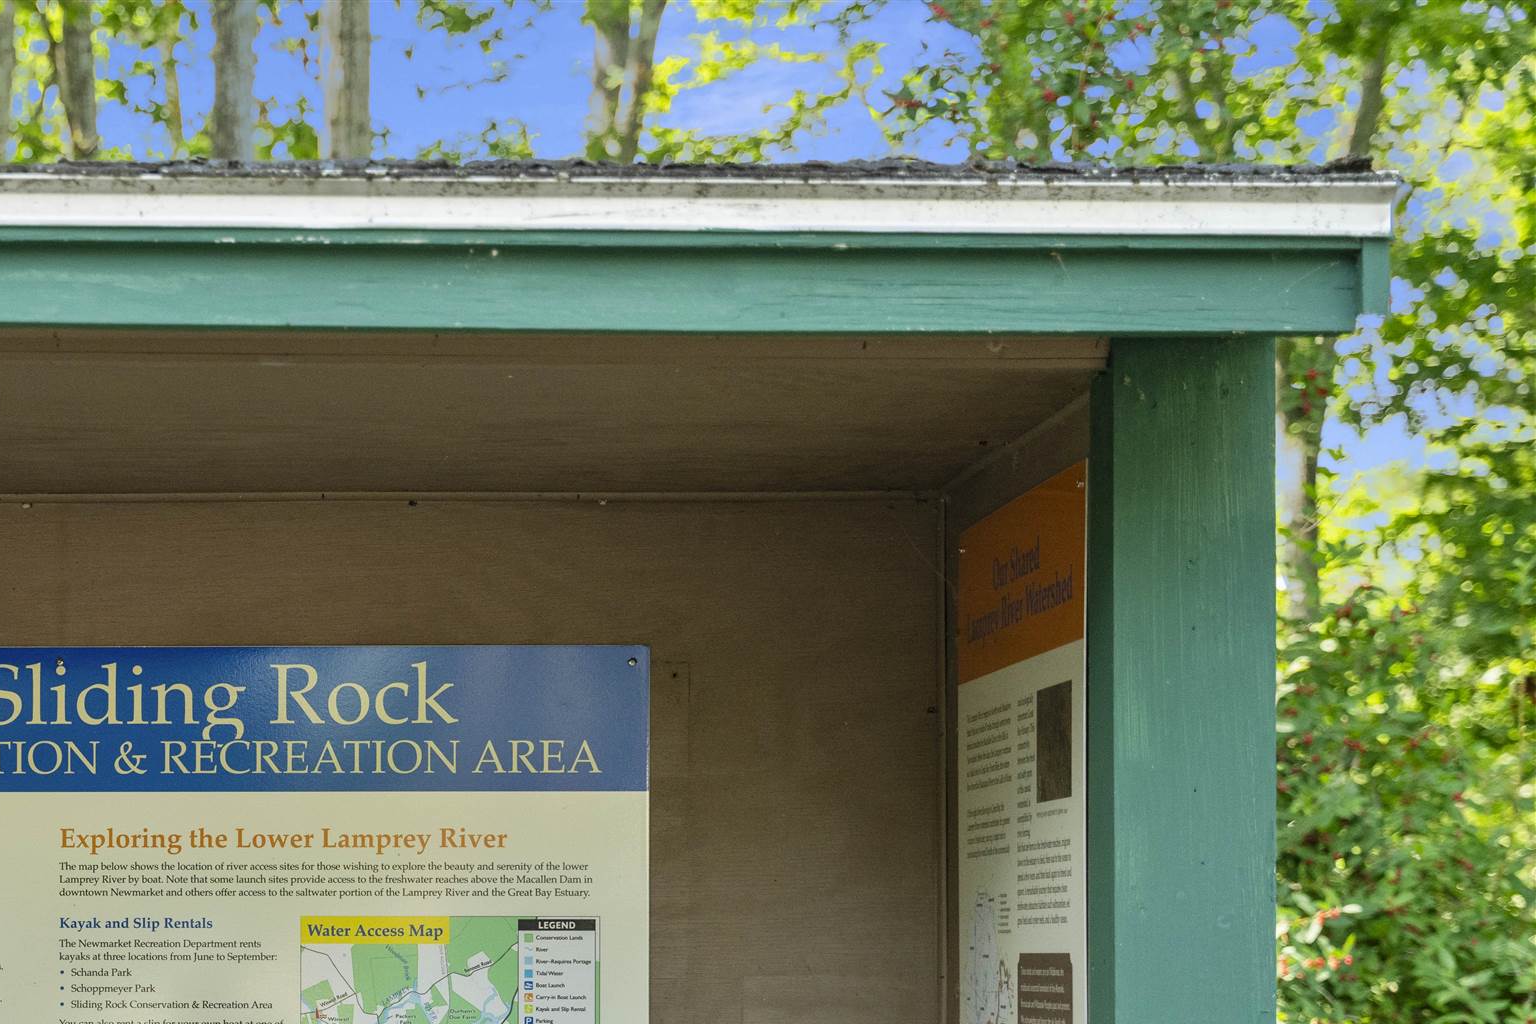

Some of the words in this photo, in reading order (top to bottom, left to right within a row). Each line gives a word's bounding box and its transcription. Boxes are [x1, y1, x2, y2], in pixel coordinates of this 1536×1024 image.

[270, 663, 460, 725] Rock
[113, 741, 147, 775] &
[161, 740, 461, 776] RECREATION
[472, 740, 602, 773] AREA
[60, 827, 182, 855] Exploring
[189, 827, 228, 848] the
[235, 828, 314, 849] Lower
[321, 828, 431, 855] Lamprey
[440, 827, 507, 848] River
[59, 917, 101, 932] Kayak
[105, 917, 129, 929] and
[133, 917, 160, 932] Slip
[164, 917, 213, 929] Rentals
[308, 924, 351, 936] Water
[355, 924, 404, 936] Access
[409, 924, 443, 940] Map
[538, 921, 576, 929] LEGEND
[71, 968, 109, 977] Schanda
[111, 968, 132, 977] Park
[71, 984, 133, 995] Schoppmeyer
[135, 984, 156, 993] Park
[70, 1000, 103, 1011] Sliding
[105, 1000, 128, 1009] Rock
[129, 1000, 190, 1009] Conservation
[191, 1000, 200, 1009] &
[202, 1000, 249, 1009] Recreation
[251, 1001, 273, 1009] Area
